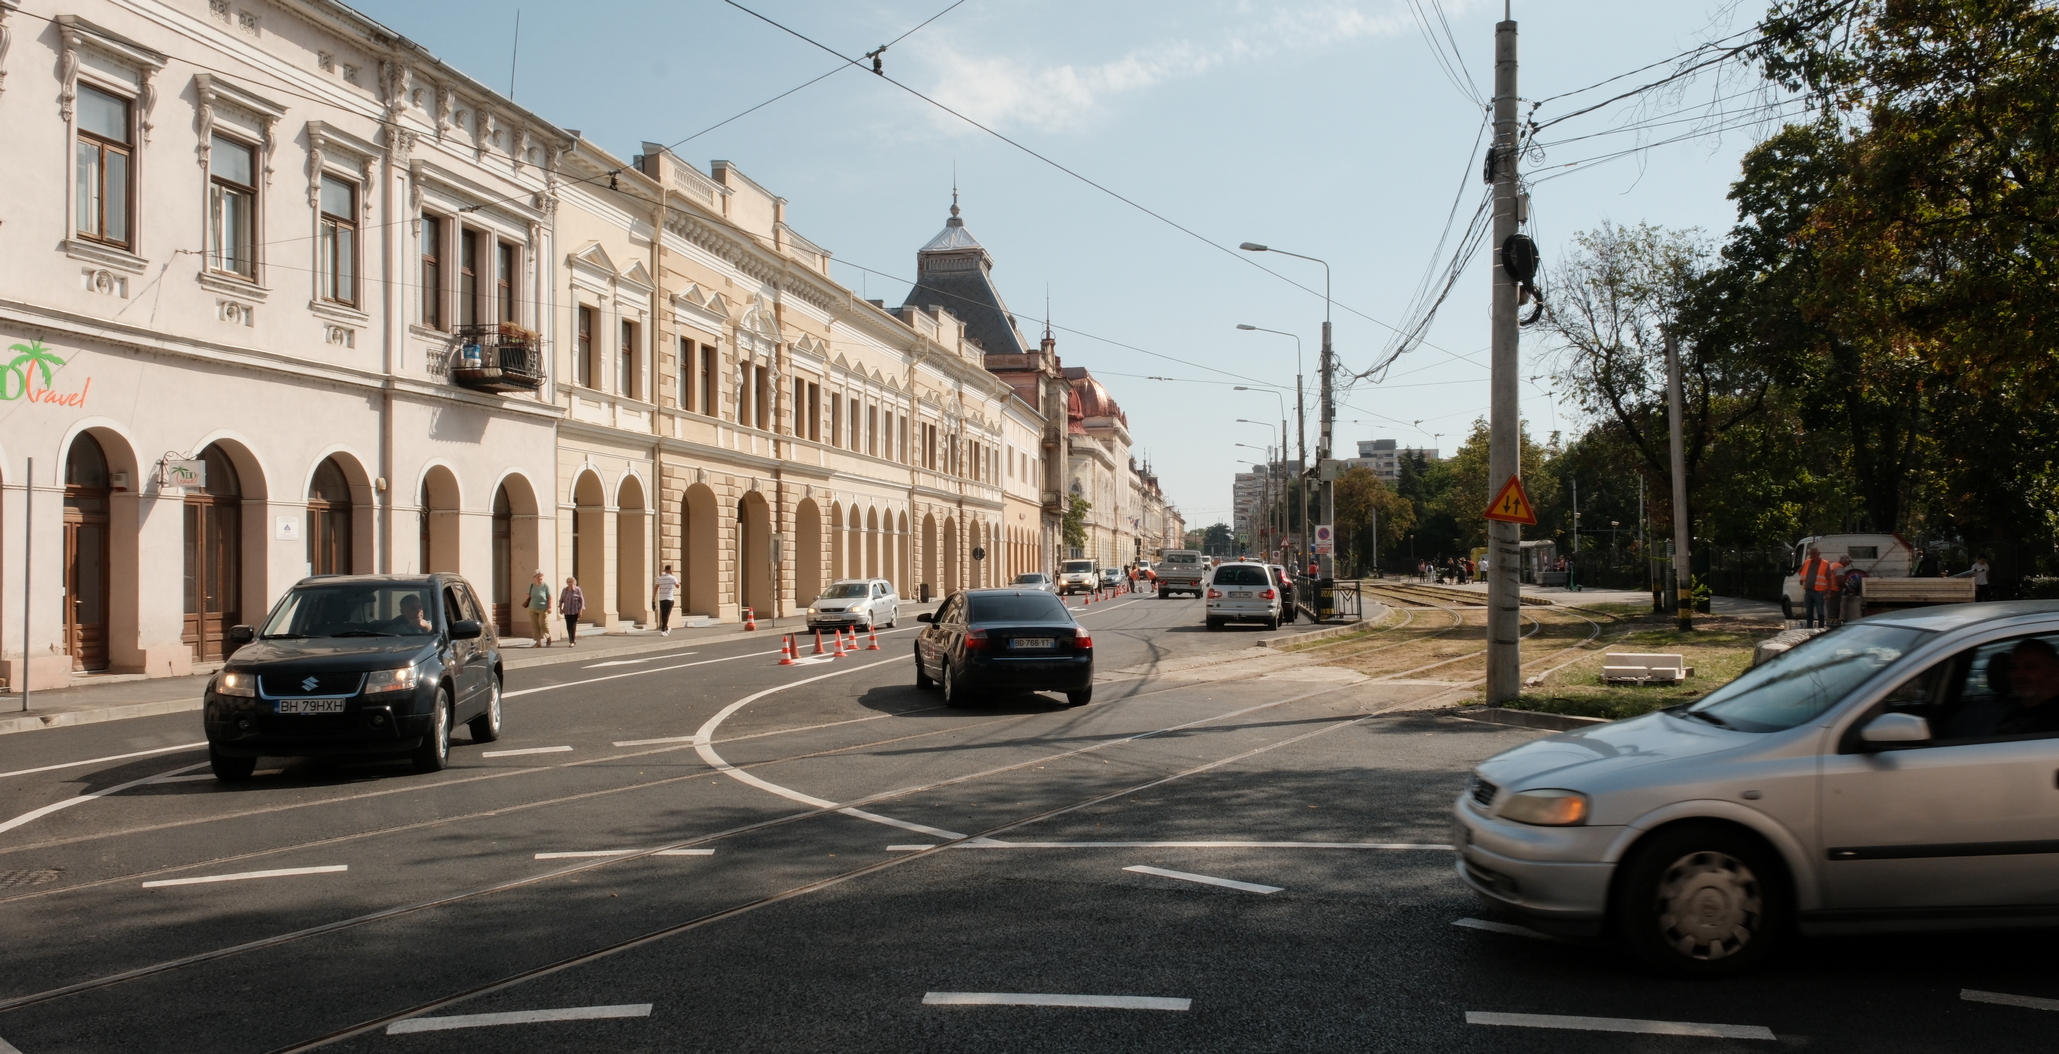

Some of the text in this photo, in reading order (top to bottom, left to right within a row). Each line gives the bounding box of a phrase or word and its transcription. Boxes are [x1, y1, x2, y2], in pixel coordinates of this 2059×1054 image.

[0, 364, 25, 400] D
[185, 471, 197, 479] DD
[281, 700, 343, 712] BH 79HXH
